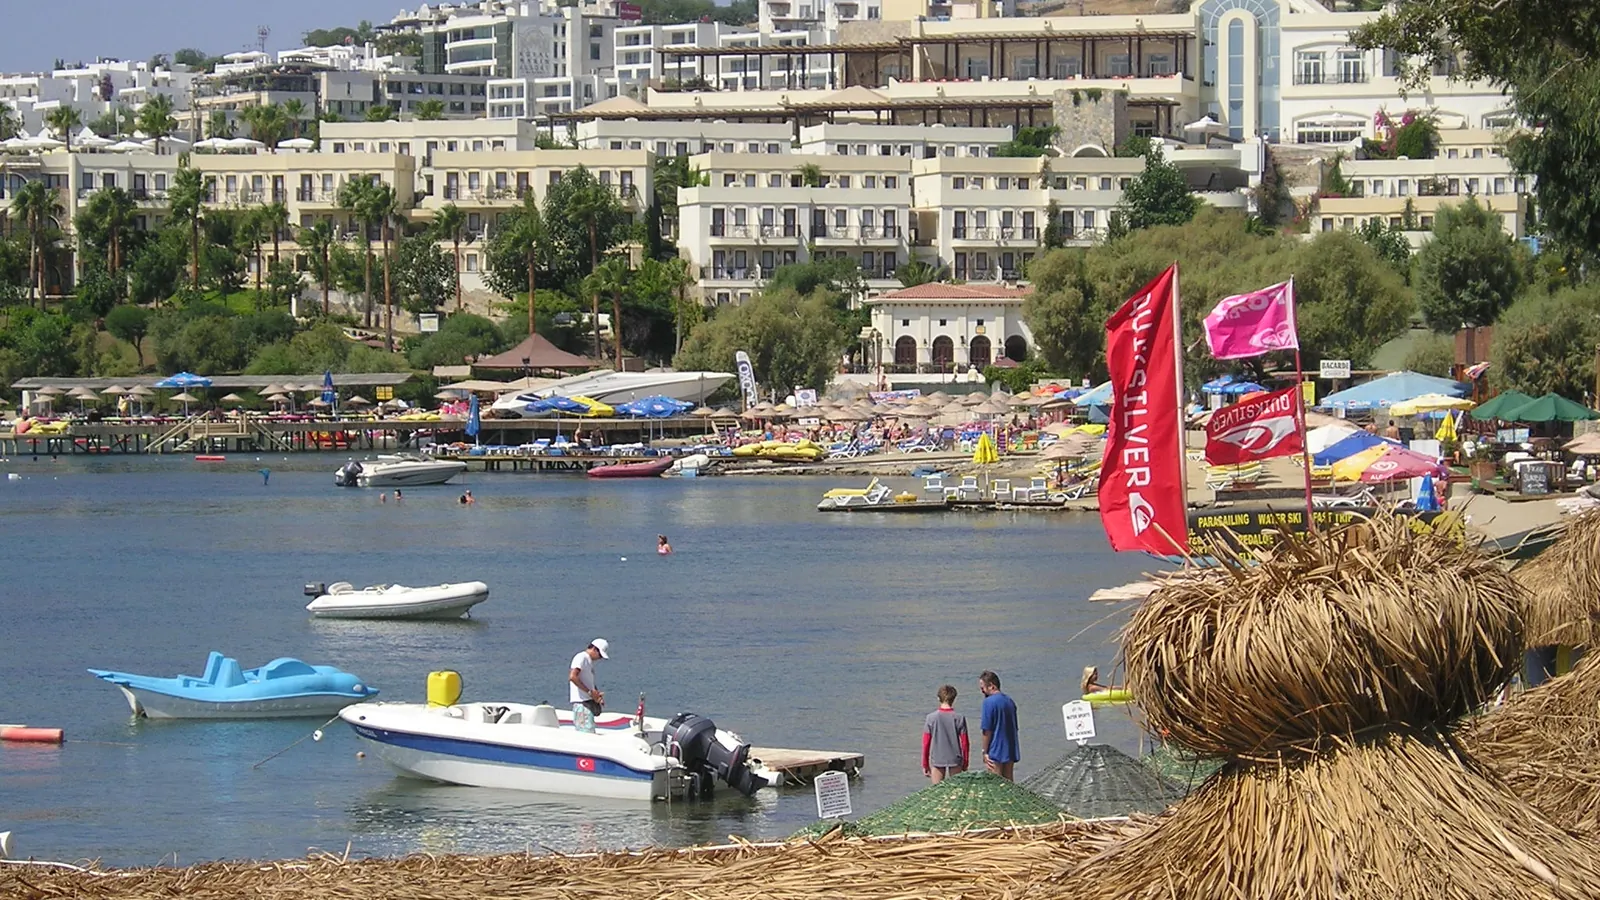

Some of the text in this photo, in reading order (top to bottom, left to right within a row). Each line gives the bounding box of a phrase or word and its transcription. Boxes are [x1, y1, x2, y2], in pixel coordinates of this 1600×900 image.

[1212, 393, 1290, 432] QUIKSILVER
[1198, 514, 1250, 528] PARASAILING
[1257, 513, 1286, 525] WATER
[1287, 512, 1302, 524] SKI
